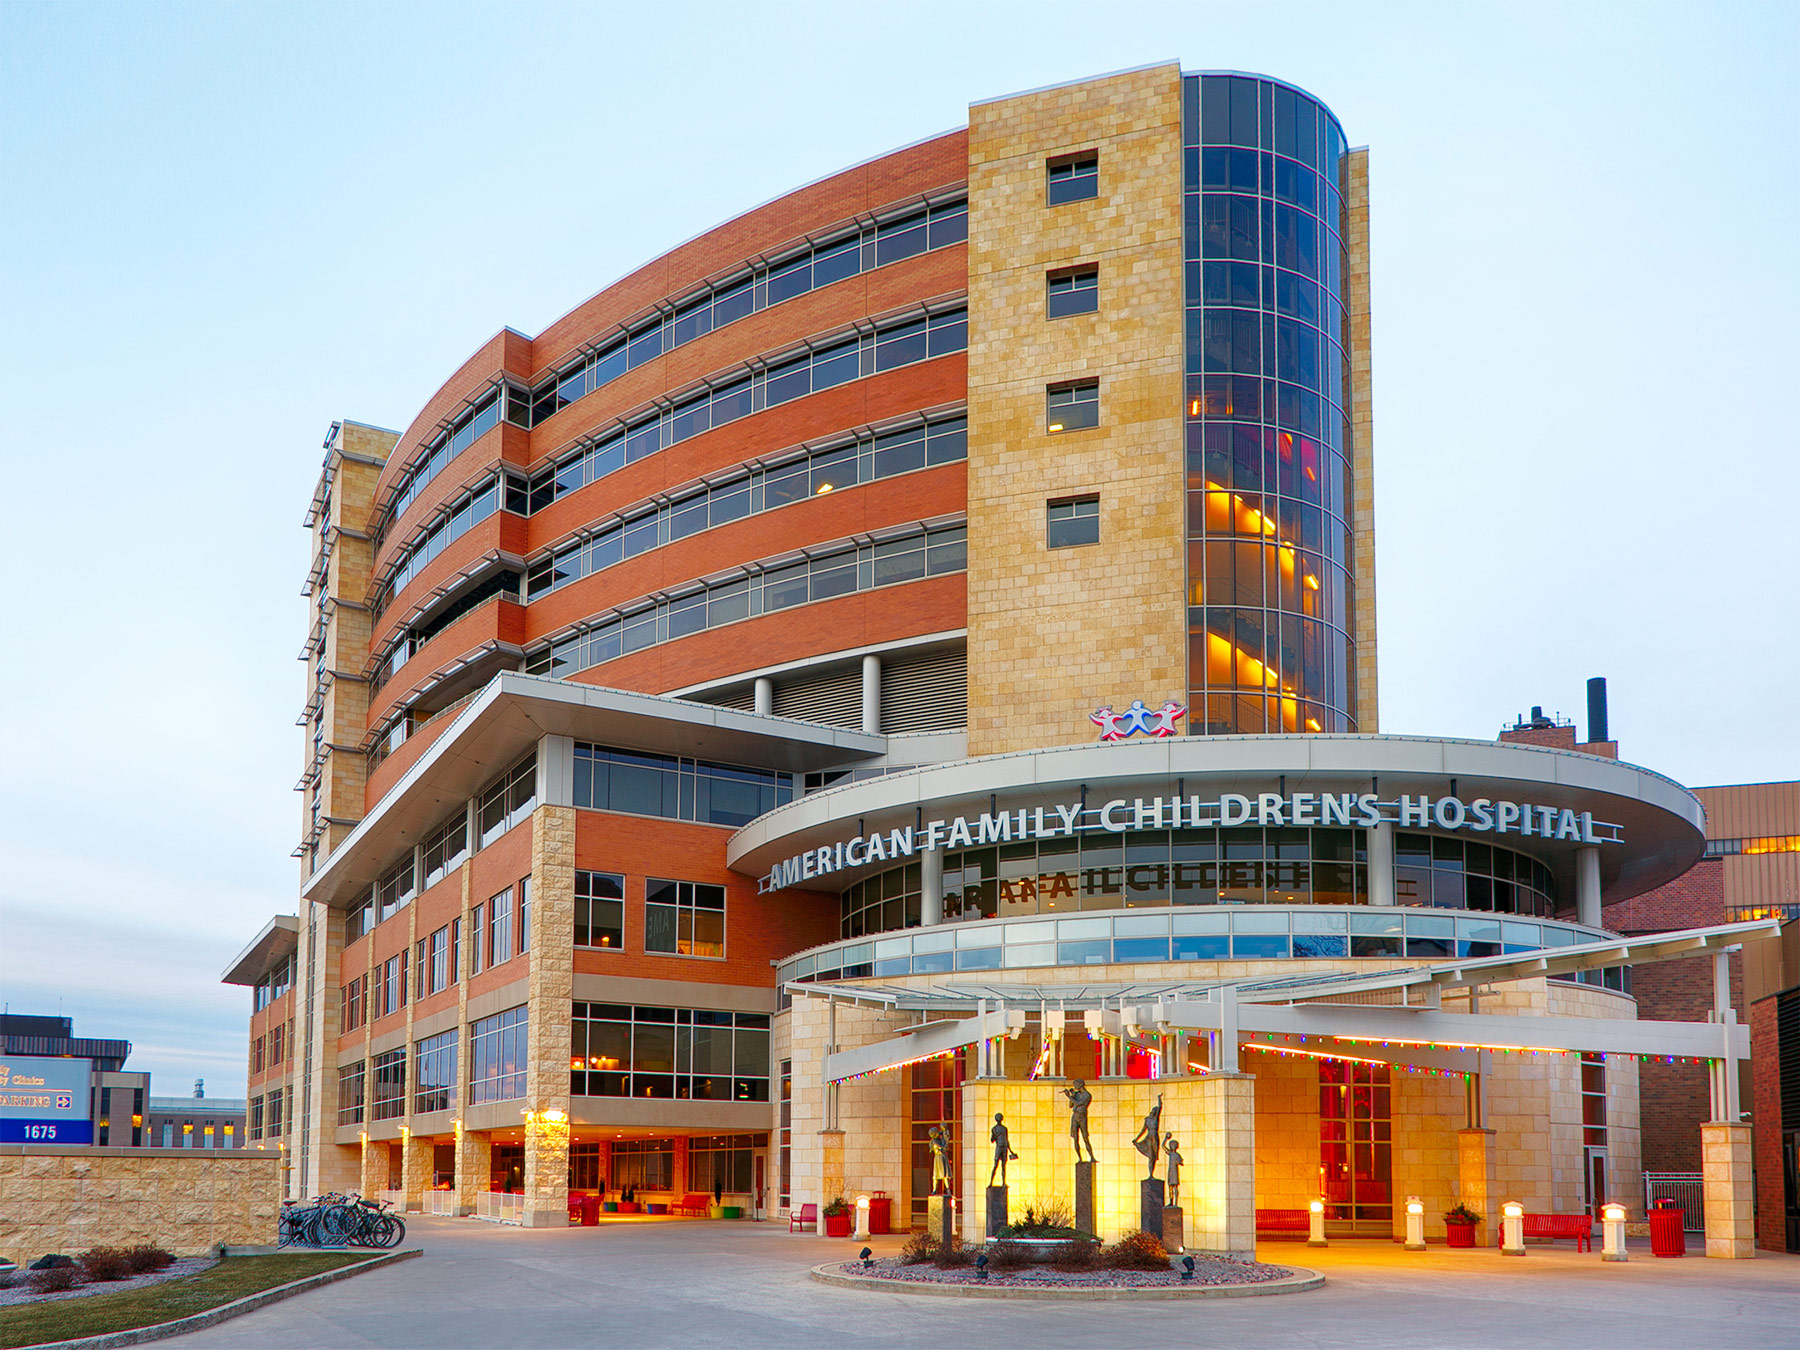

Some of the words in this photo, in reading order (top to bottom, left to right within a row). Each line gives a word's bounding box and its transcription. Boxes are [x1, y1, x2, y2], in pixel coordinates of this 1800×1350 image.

[768, 824, 914, 893] AMERICAN
[927, 802, 1083, 851] FAMILY
[1100, 793, 1381, 833] CHILDREN'S
[1400, 794, 1602, 844] HOSPITAL
[24, 1125, 57, 1139] 1675
